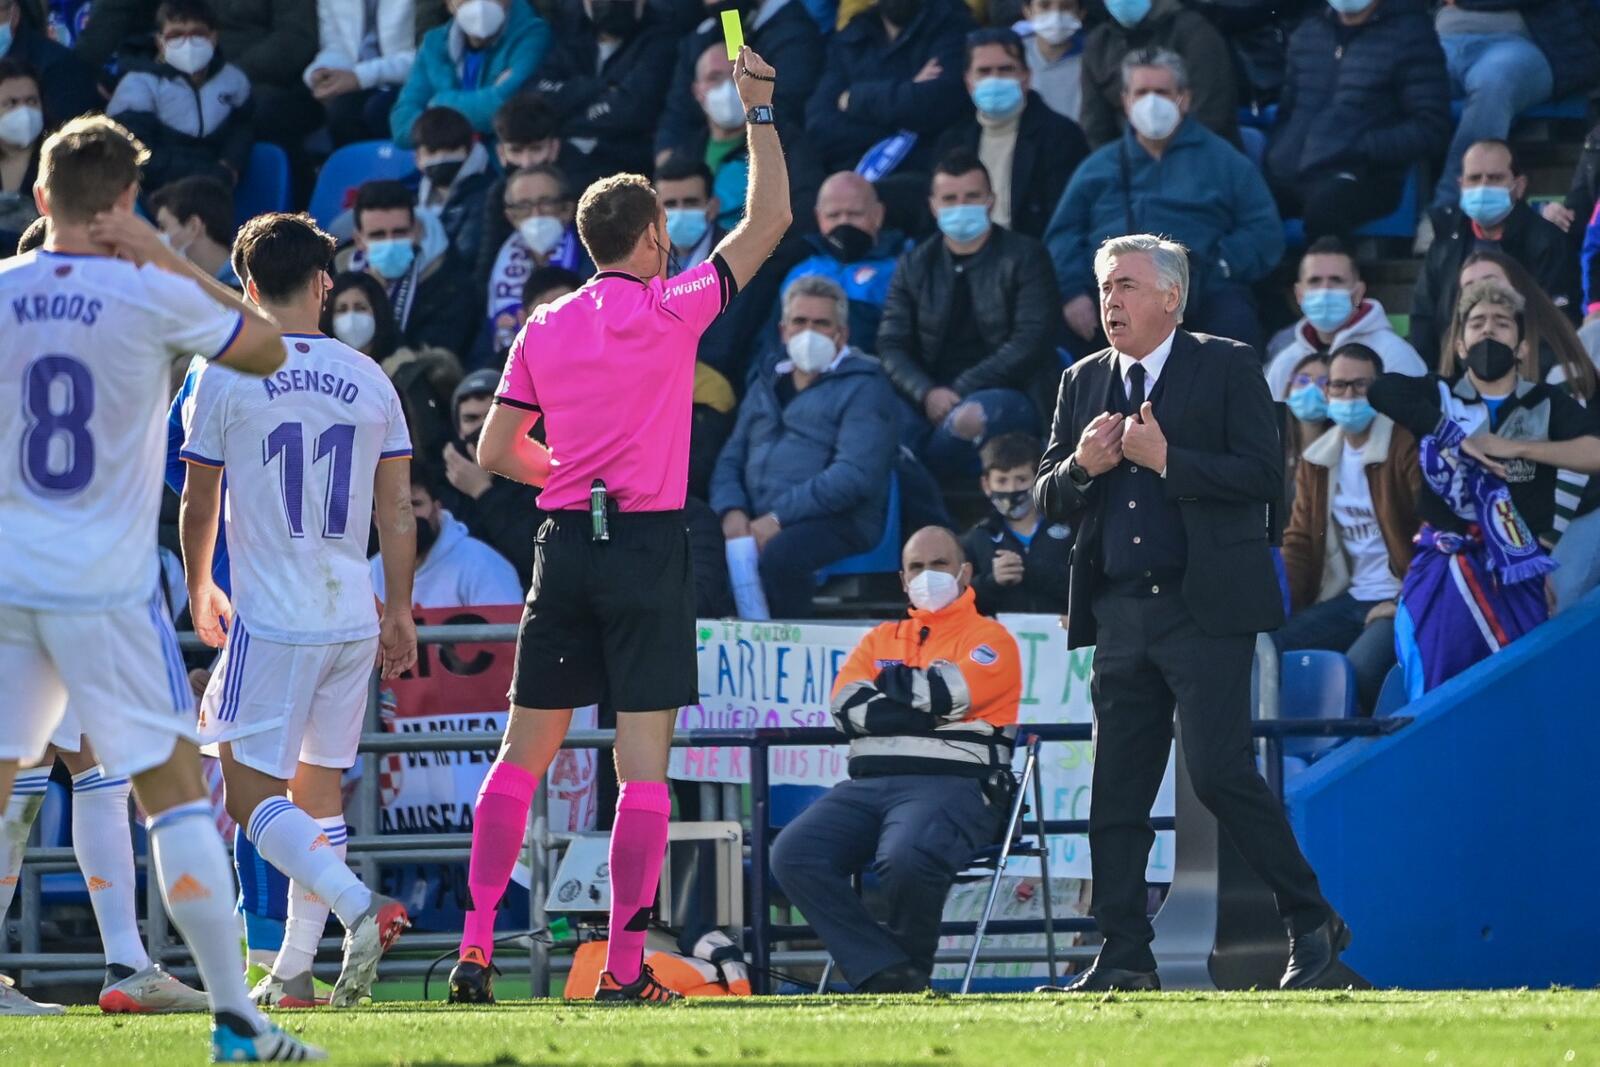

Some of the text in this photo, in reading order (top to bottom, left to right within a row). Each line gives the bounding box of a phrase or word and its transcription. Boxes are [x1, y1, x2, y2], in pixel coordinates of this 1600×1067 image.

[672, 273, 716, 297] WÜRTH
[12, 293, 102, 327] KROOS
[262, 369, 360, 404] ASENSIO
[21, 353, 96, 496] 8
[262, 421, 357, 540] 11
